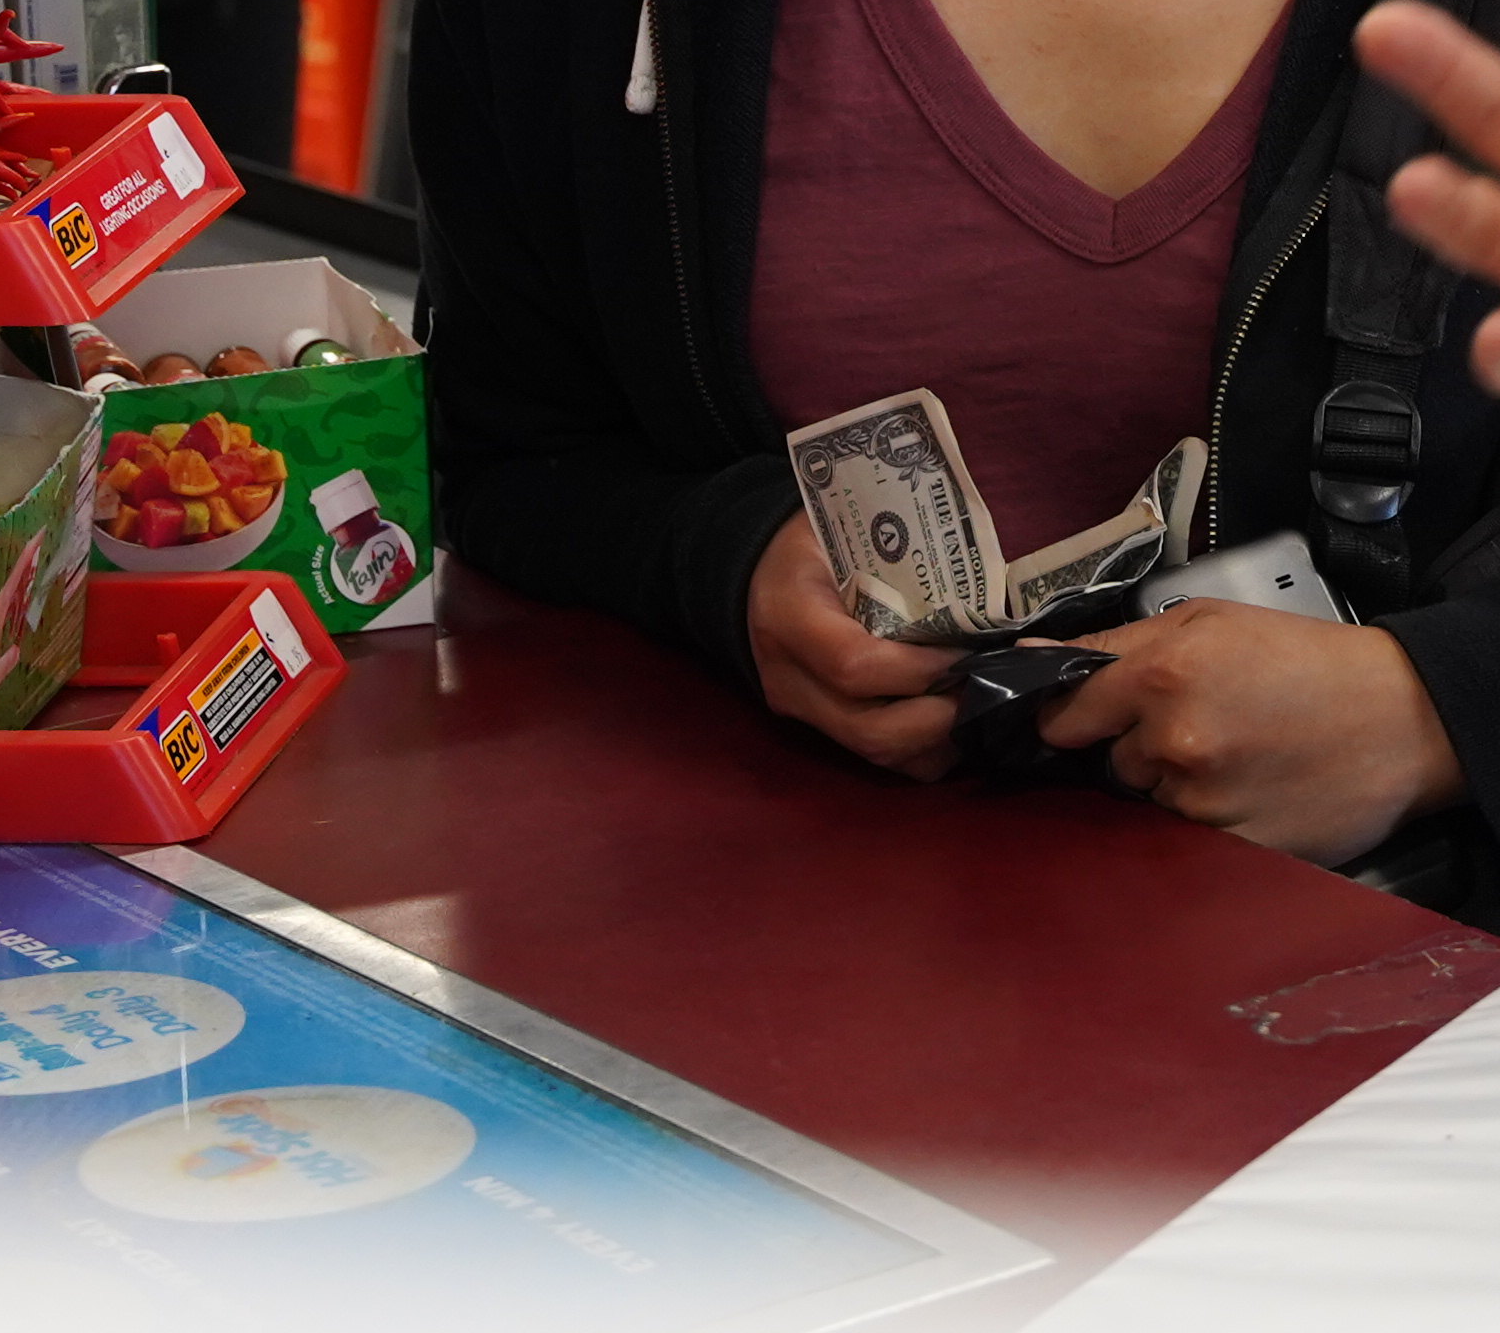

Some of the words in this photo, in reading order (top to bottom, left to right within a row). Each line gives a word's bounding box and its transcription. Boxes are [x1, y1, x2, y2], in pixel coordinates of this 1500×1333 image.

[100, 185, 126, 210] GREAT
[99, 204, 133, 236] LIGHTING
[929, 478, 953, 526] THE
[880, 529, 896, 547] A
[312, 544, 325, 570] Size
[311, 568, 335, 605] Actual
[911, 549, 936, 603] COPY
[969, 547, 986, 603] MOTION
[85, 986, 125, 1000] 3
[115, 994, 198, 1036] Daily
[462, 1174, 536, 1209] MIN
